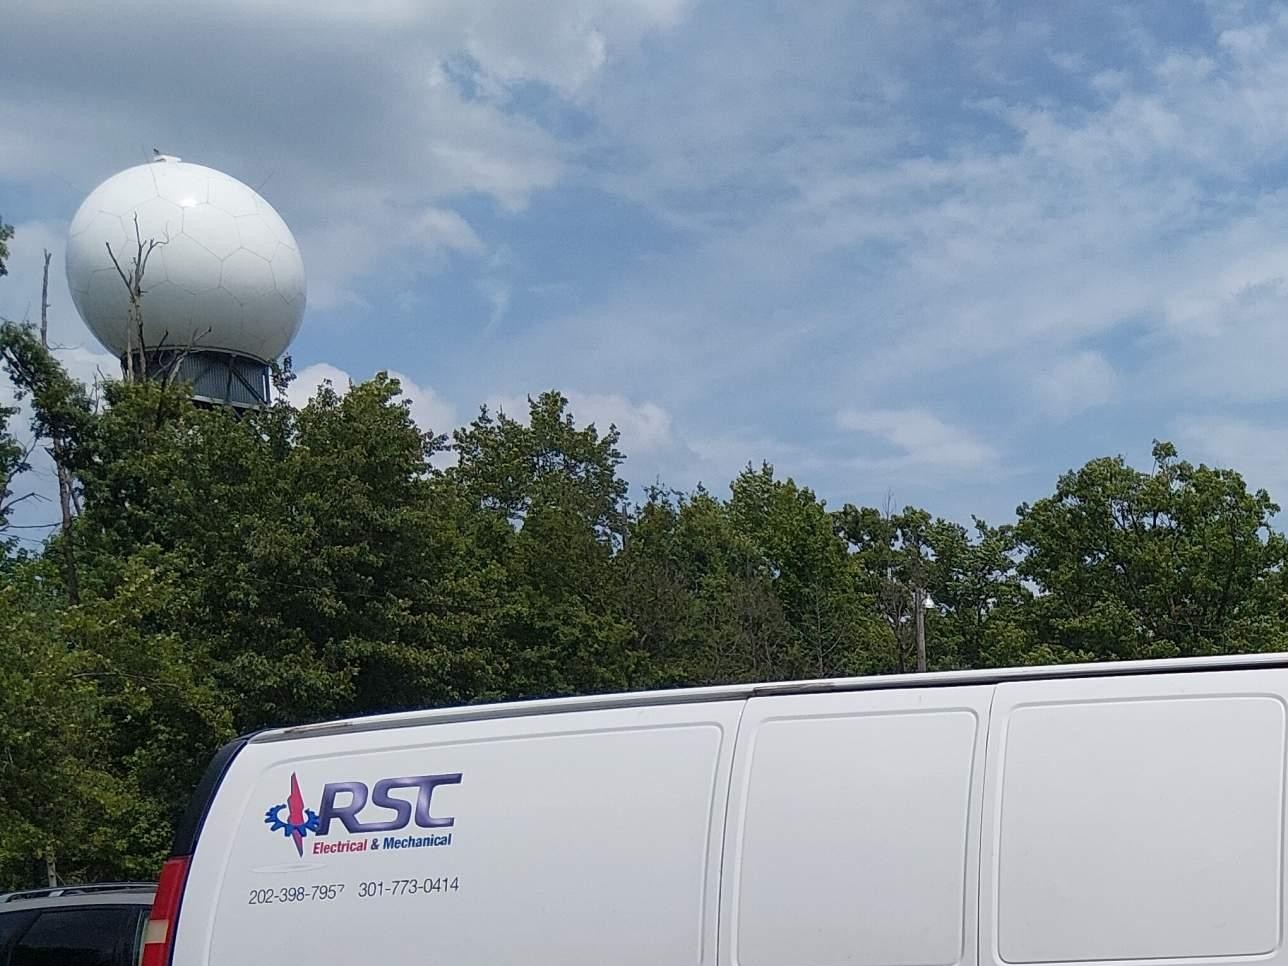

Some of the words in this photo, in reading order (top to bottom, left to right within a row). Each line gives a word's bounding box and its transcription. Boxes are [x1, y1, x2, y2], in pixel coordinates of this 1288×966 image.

[312, 839, 367, 854] Electrical
[370, 838, 379, 850] &
[383, 833, 452, 850] Mechanical
[358, 877, 460, 897] 301-773-0414
